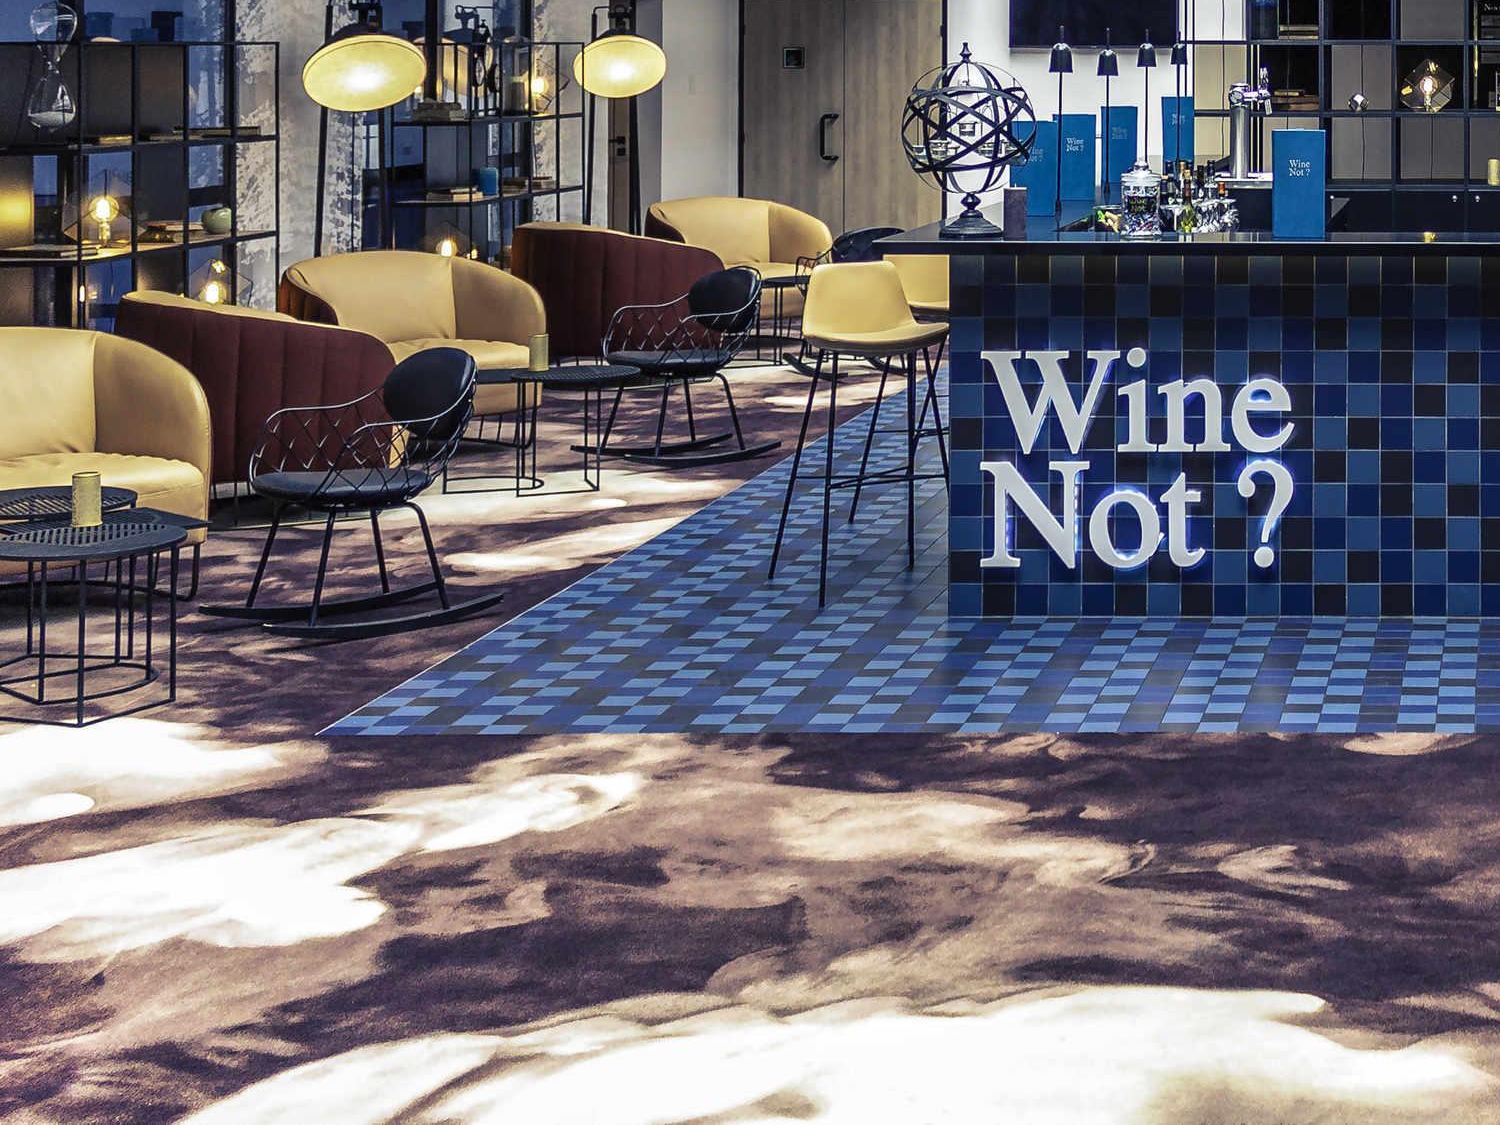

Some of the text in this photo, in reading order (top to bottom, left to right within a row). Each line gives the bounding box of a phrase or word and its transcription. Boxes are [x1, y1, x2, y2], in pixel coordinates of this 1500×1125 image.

[1289, 159, 1311, 168] Wine
[1289, 168, 1304, 176] Not
[980, 347, 1295, 455] Wine
[980, 460, 1206, 569] Not
